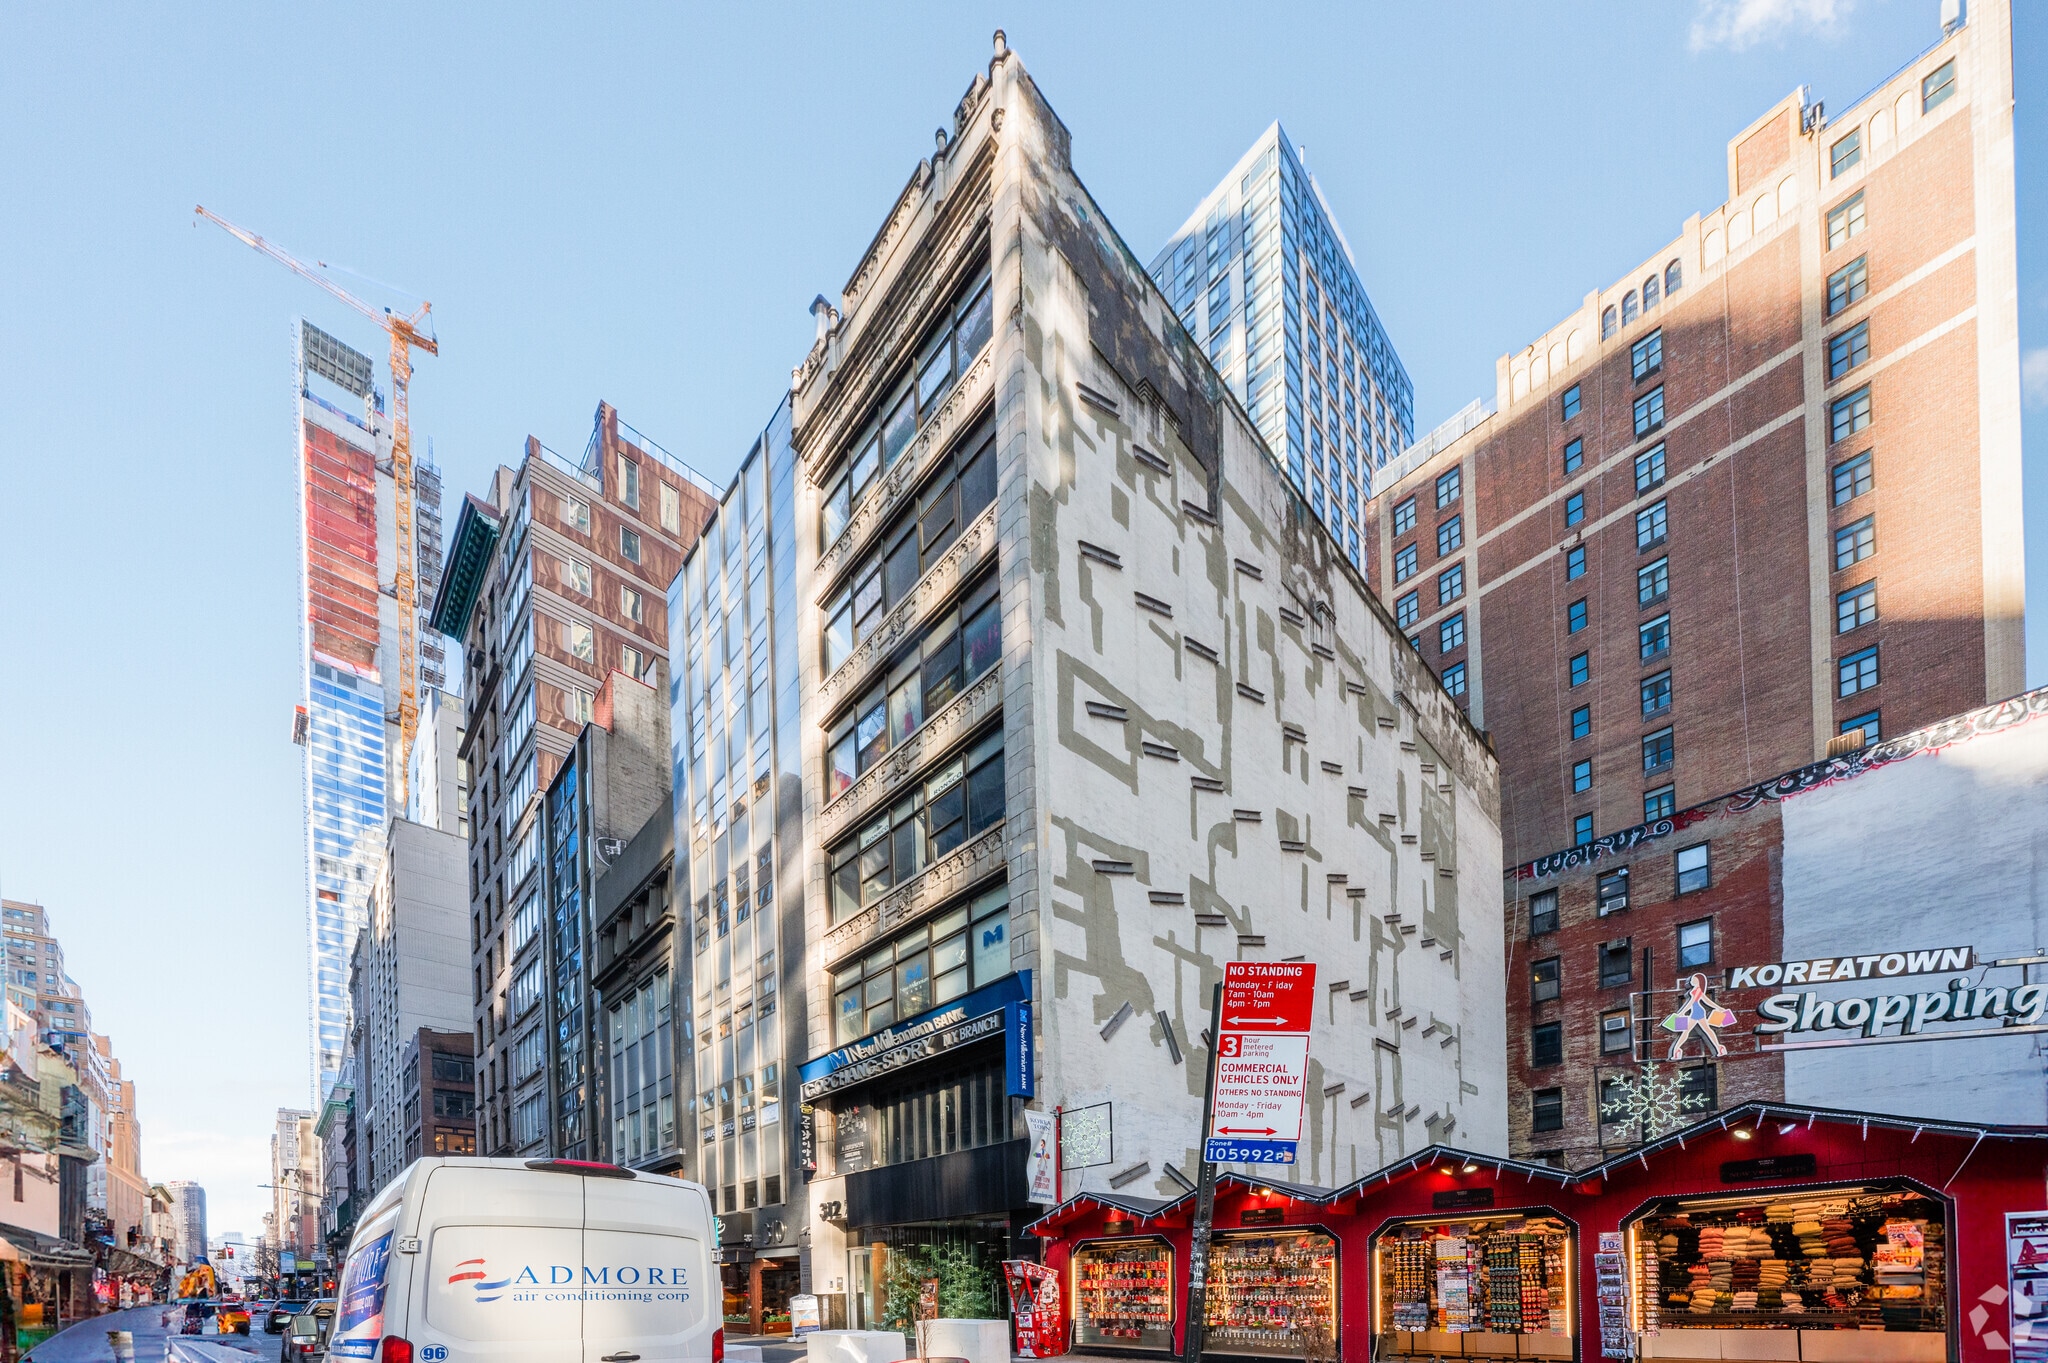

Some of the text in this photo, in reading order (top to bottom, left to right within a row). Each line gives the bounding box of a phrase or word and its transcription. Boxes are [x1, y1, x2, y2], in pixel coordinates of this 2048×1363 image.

[1229, 966, 1303, 977] NO STANDING
[1730, 948, 1970, 988] KOREATOWN
[1228, 981, 1260, 991] Monday
[1268, 981, 1293, 991] Fiday
[1228, 990, 1245, 998] 7am
[1253, 990, 1274, 998] 10am
[1227, 999, 1245, 1008] 4pm
[1253, 999, 1270, 1008] 7pm
[1753, 977, 2048, 1038] Shopping
[933, 1007, 968, 1029] BANK
[959, 1014, 1000, 1041] BRANCH
[1222, 1036, 1238, 1056] 3
[1242, 1050, 1270, 1058] parking
[1221, 1063, 1288, 1073] COMMERCIAL
[1220, 1074, 1299, 1085] VEHICLES ONLY
[1219, 1088, 1249, 1096] OTHERS
[1264, 1089, 1302, 1097] STANDING
[1217, 1101, 1249, 1110] Monday
[1256, 1102, 1282, 1111] Friday
[1217, 1110, 1238, 1118] 10am
[1246, 1111, 1264, 1119] 4pm
[1209, 1147, 1274, 1162] 105992
[819, 1200, 842, 1222] 312
[515, 1265, 688, 1285] ADMORE
[513, 1290, 690, 1302] air conditioning corp
[1018, 1331, 1035, 1339] ATM
[423, 1347, 446, 1360] 96
